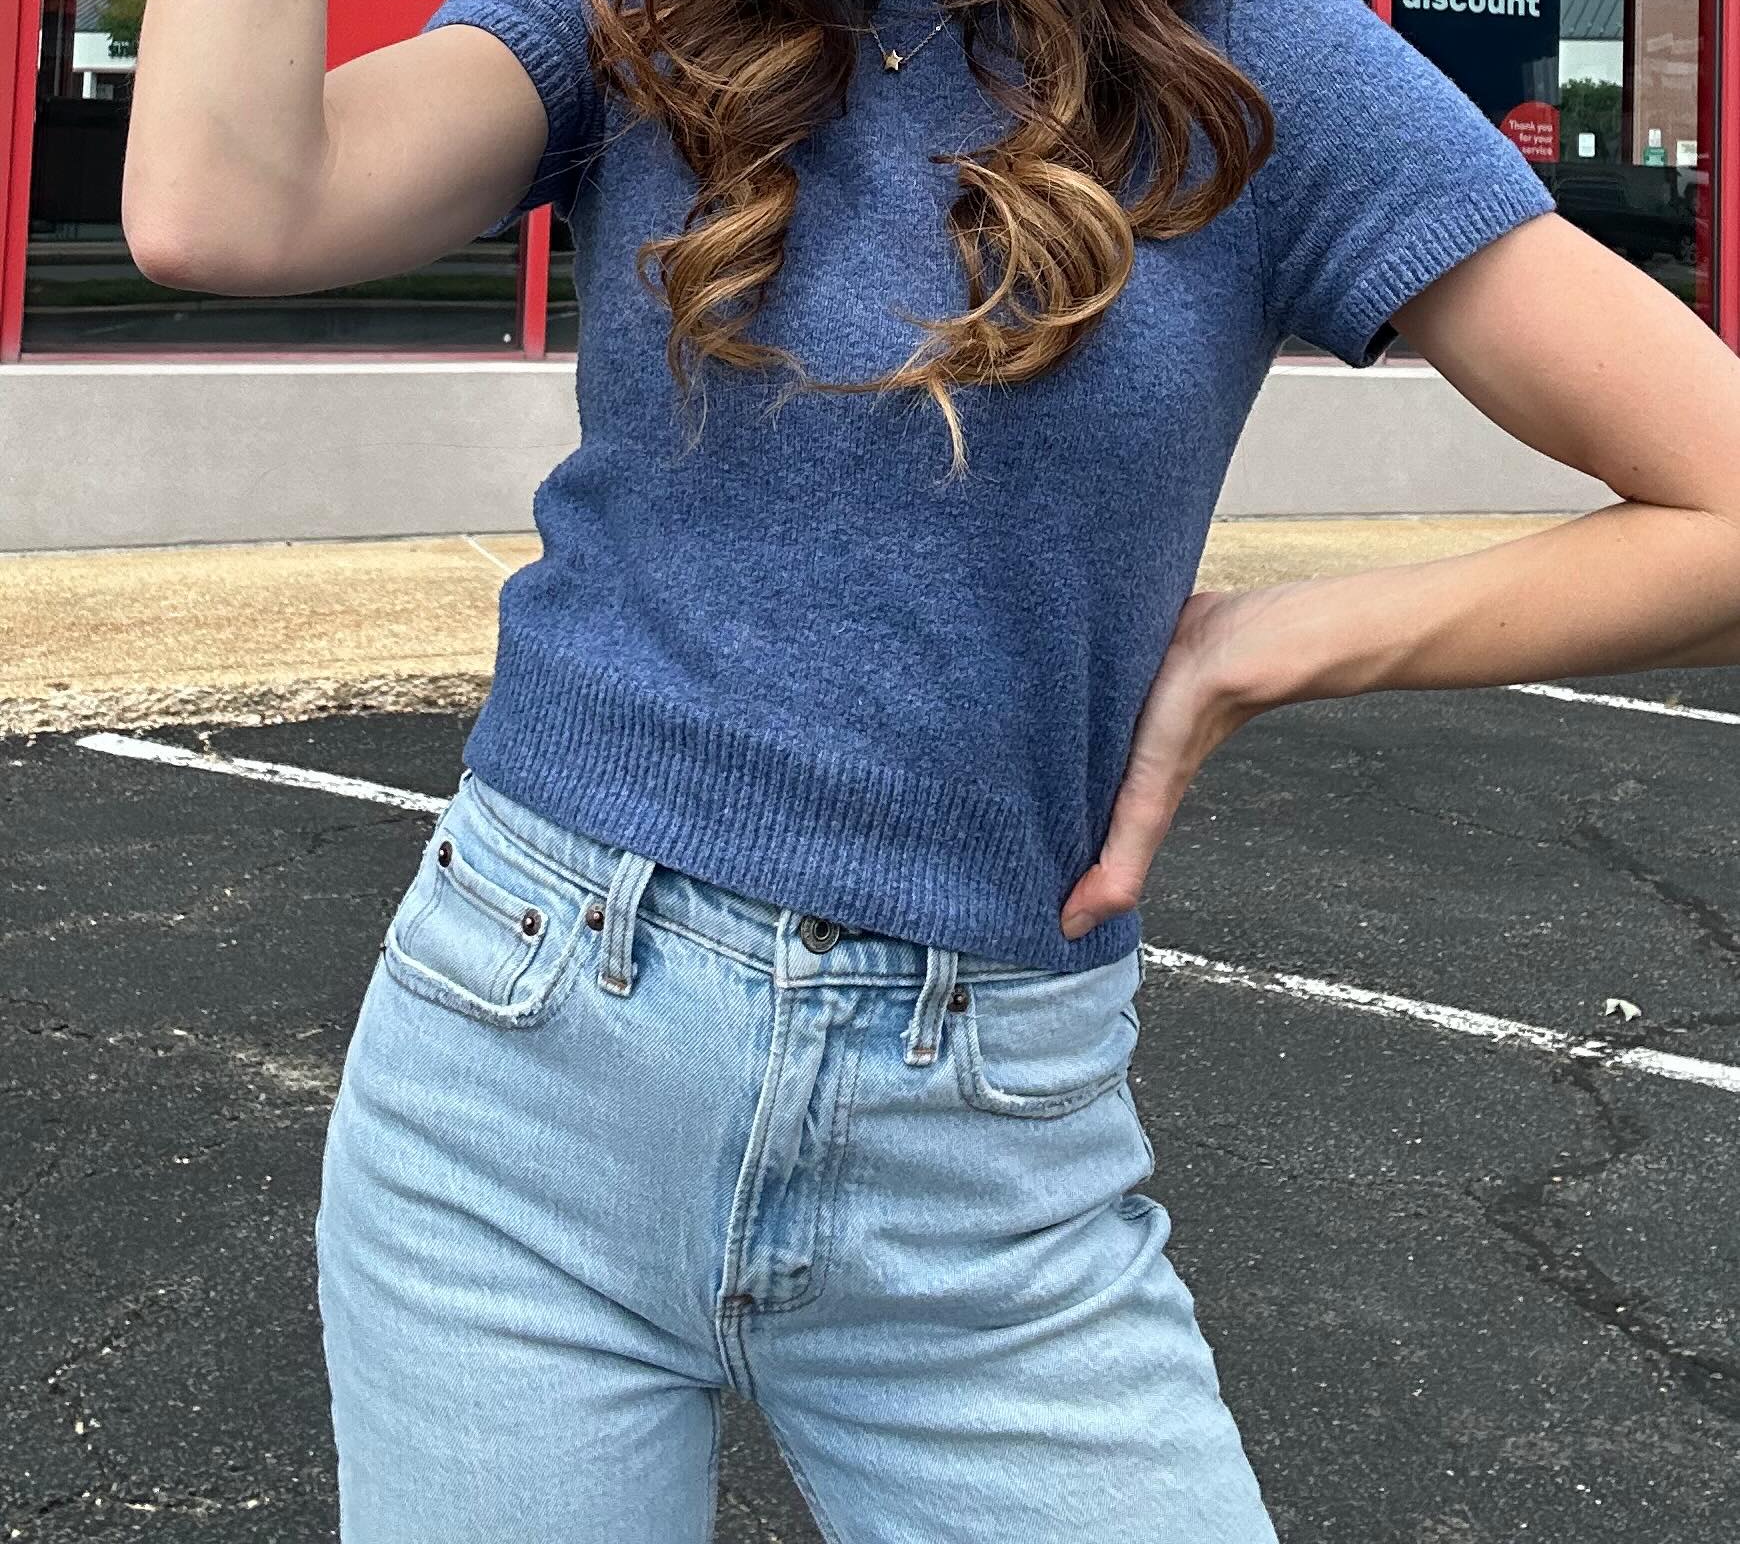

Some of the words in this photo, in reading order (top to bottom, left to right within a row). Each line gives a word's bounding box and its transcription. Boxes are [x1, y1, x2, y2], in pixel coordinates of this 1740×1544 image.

[1509, 119, 1535, 131] Thank
[1537, 124, 1553, 133] you
[1519, 133, 1531, 142] for
[1533, 136, 1553, 144] your
[1522, 146, 1553, 155] service
